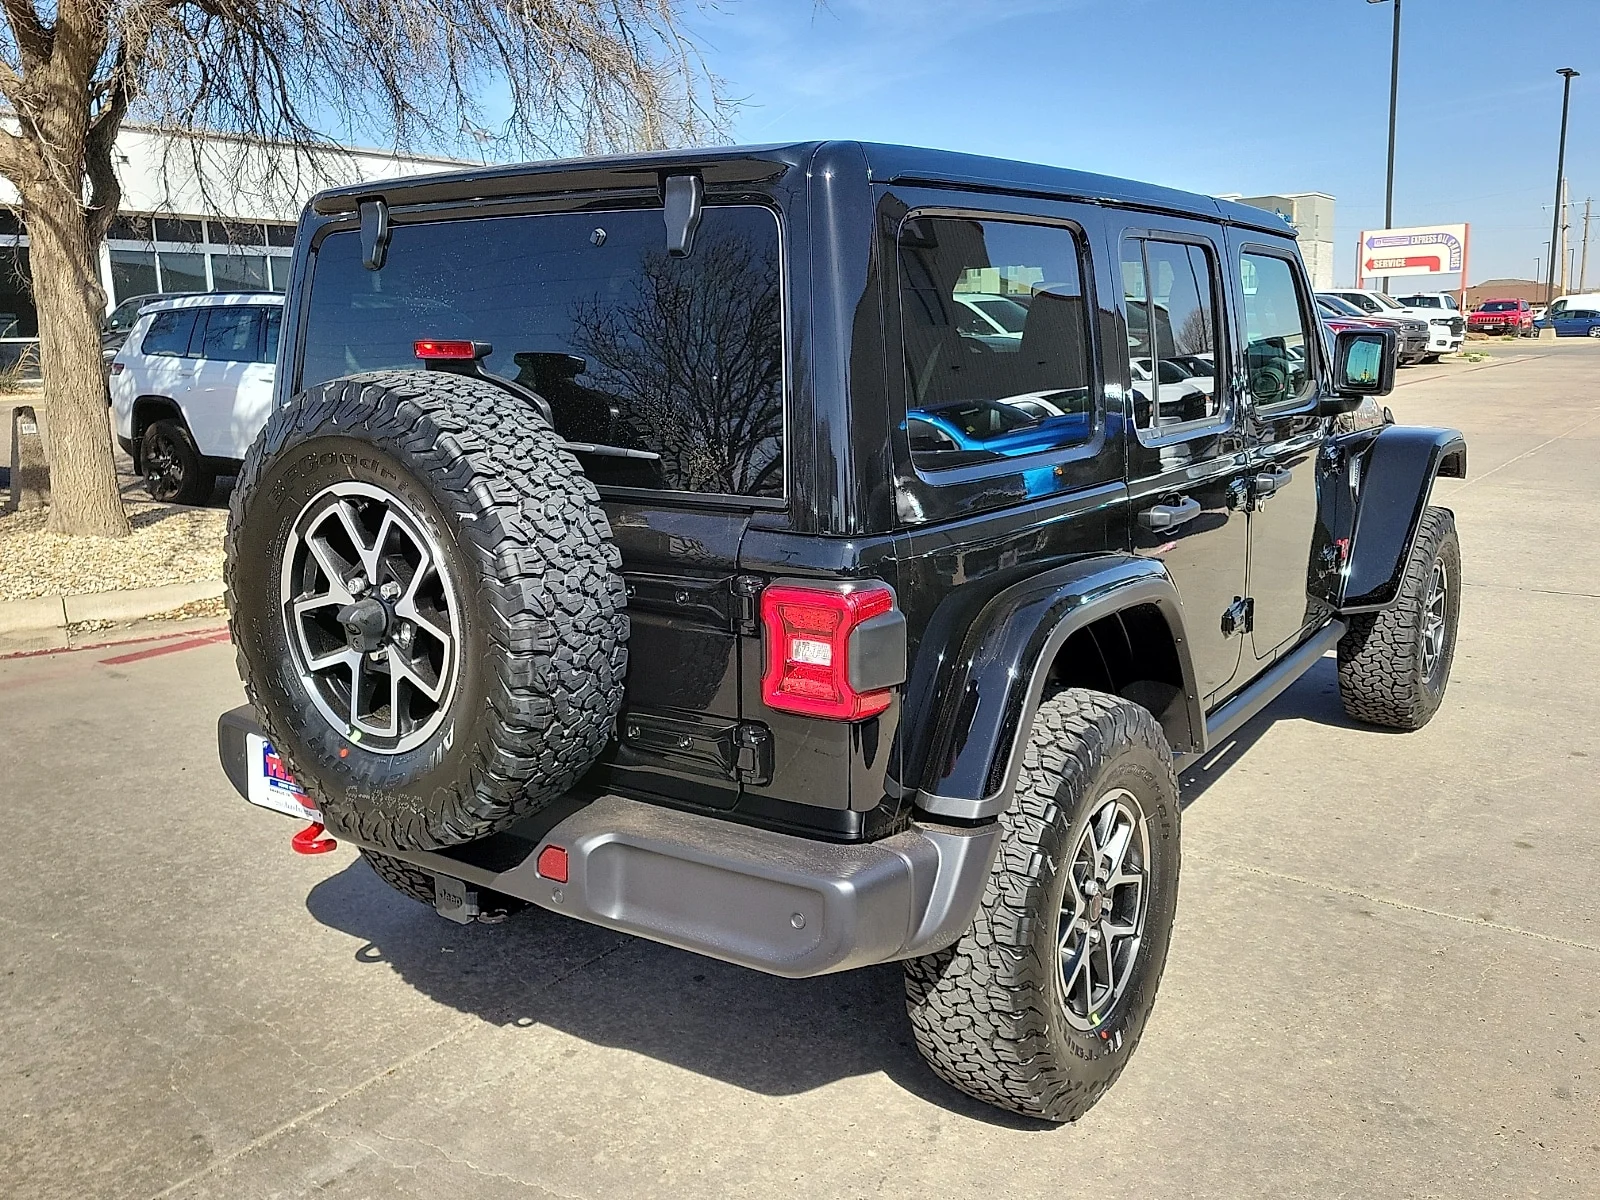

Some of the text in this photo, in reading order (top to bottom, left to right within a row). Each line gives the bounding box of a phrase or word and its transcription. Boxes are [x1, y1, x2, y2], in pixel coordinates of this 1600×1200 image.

[1411, 234, 1437, 245] EXPRESS
[1373, 258, 1406, 269] SERVICE
[440, 889, 463, 909] Jeep
